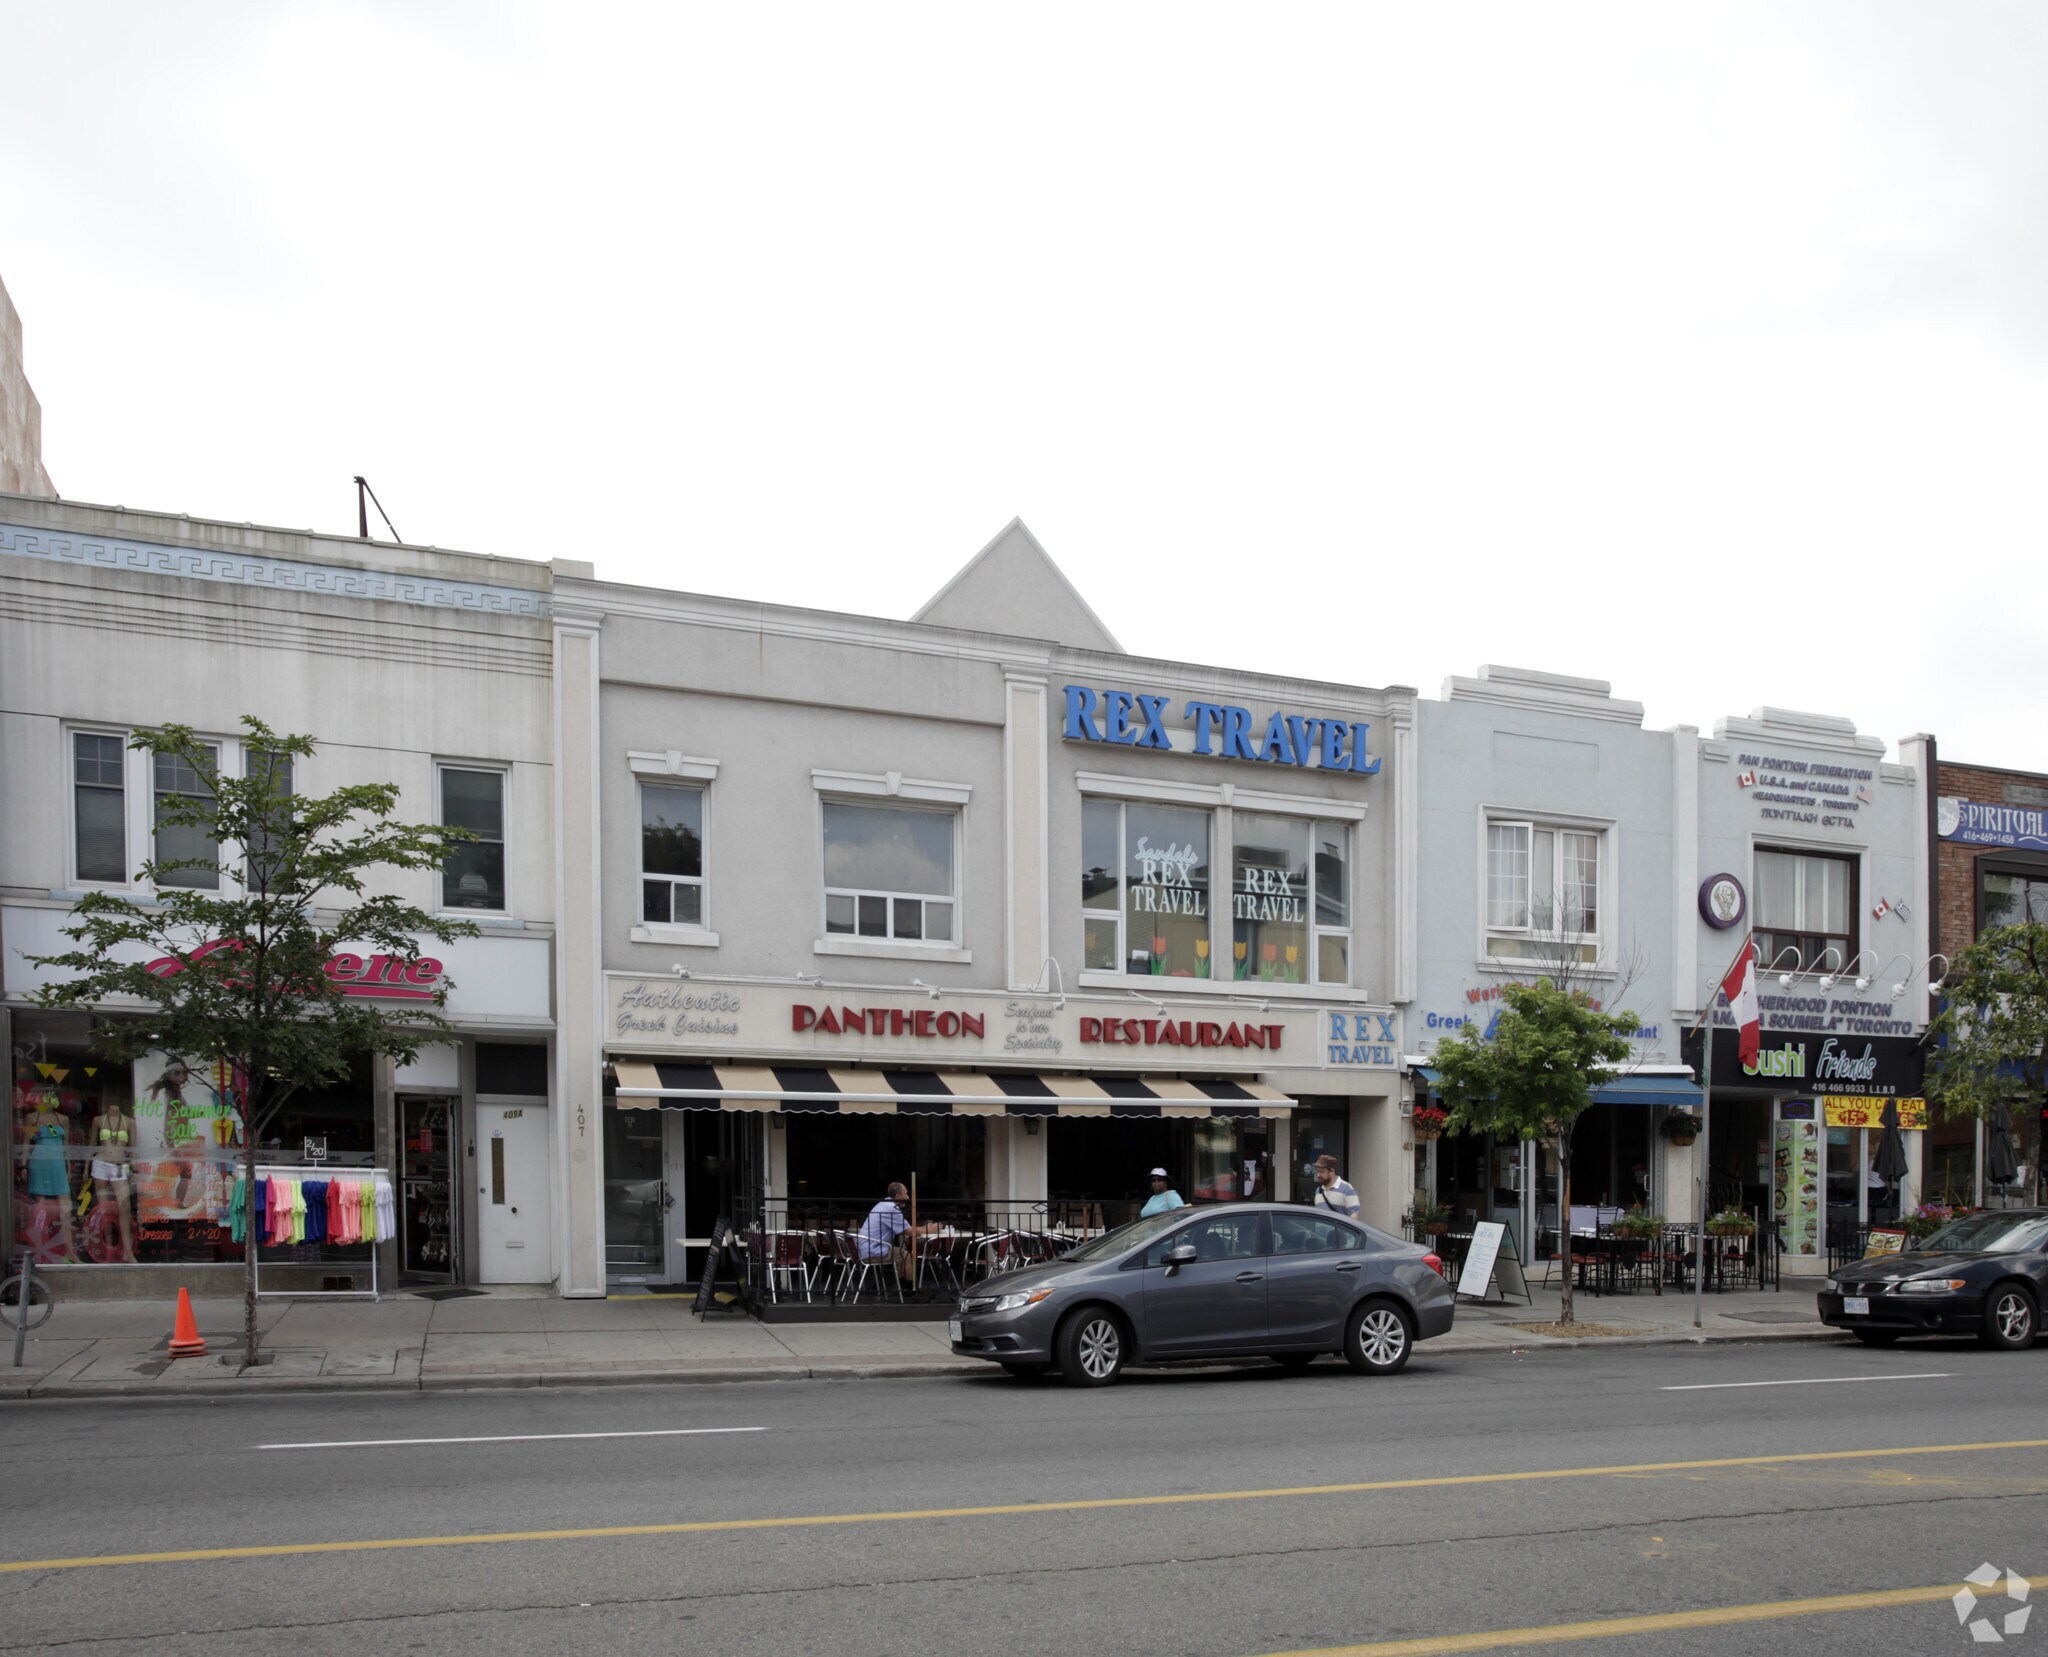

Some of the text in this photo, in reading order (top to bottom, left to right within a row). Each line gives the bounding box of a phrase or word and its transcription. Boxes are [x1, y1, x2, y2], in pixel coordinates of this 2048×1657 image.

[1063, 685, 1382, 774] REX TRAVEL
[1738, 754, 1760, 767] PAN
[1810, 764, 1873, 781] FEDERATION
[1789, 780, 1808, 791] and
[1808, 782, 1849, 795] CANADA
[1752, 791, 1859, 812] HEADQUARTERS TORONTO
[1958, 803, 2048, 837] SPIRITUAL
[1134, 836, 1199, 865] Sandals
[1141, 859, 1193, 888] REX
[1244, 867, 1293, 896] REX
[1131, 885, 1206, 917] TRAVEL
[1233, 893, 1304, 923] TRAVEL
[618, 982, 741, 1012] Authentic
[1830, 1000, 1893, 1017] PONTION
[616, 1010, 739, 1036] Greek Cuisine
[792, 1004, 984, 1039] PANTHEON
[1004, 999, 1056, 1023] Seafood
[1015, 1020, 1027, 1033] is
[1080, 1017, 1285, 1050] RESTAURANT
[1330, 1013, 1395, 1042] REX
[1846, 1017, 1913, 1035] TORONTO
[1003, 1033, 1063, 1054] Specialty
[1327, 1045, 1394, 1064] TRAVEL
[1815, 1037, 1877, 1081] Friends
[1812, 1083, 1827, 1092] 416
[1828, 1083, 1844, 1092] 466
[1845, 1084, 1866, 1093] 9933
[133, 1097, 231, 1119] Hot Summer
[503, 1109, 523, 1119] 409A
[1825, 1097, 1846, 1109] ALL
[1848, 1098, 1871, 1110] YOU
[1901, 1099, 1924, 1111] EAT
[166, 1119, 199, 1139] Sale
[577, 1103, 585, 1137] 407
[138, 1228, 174, 1241] Dresses
